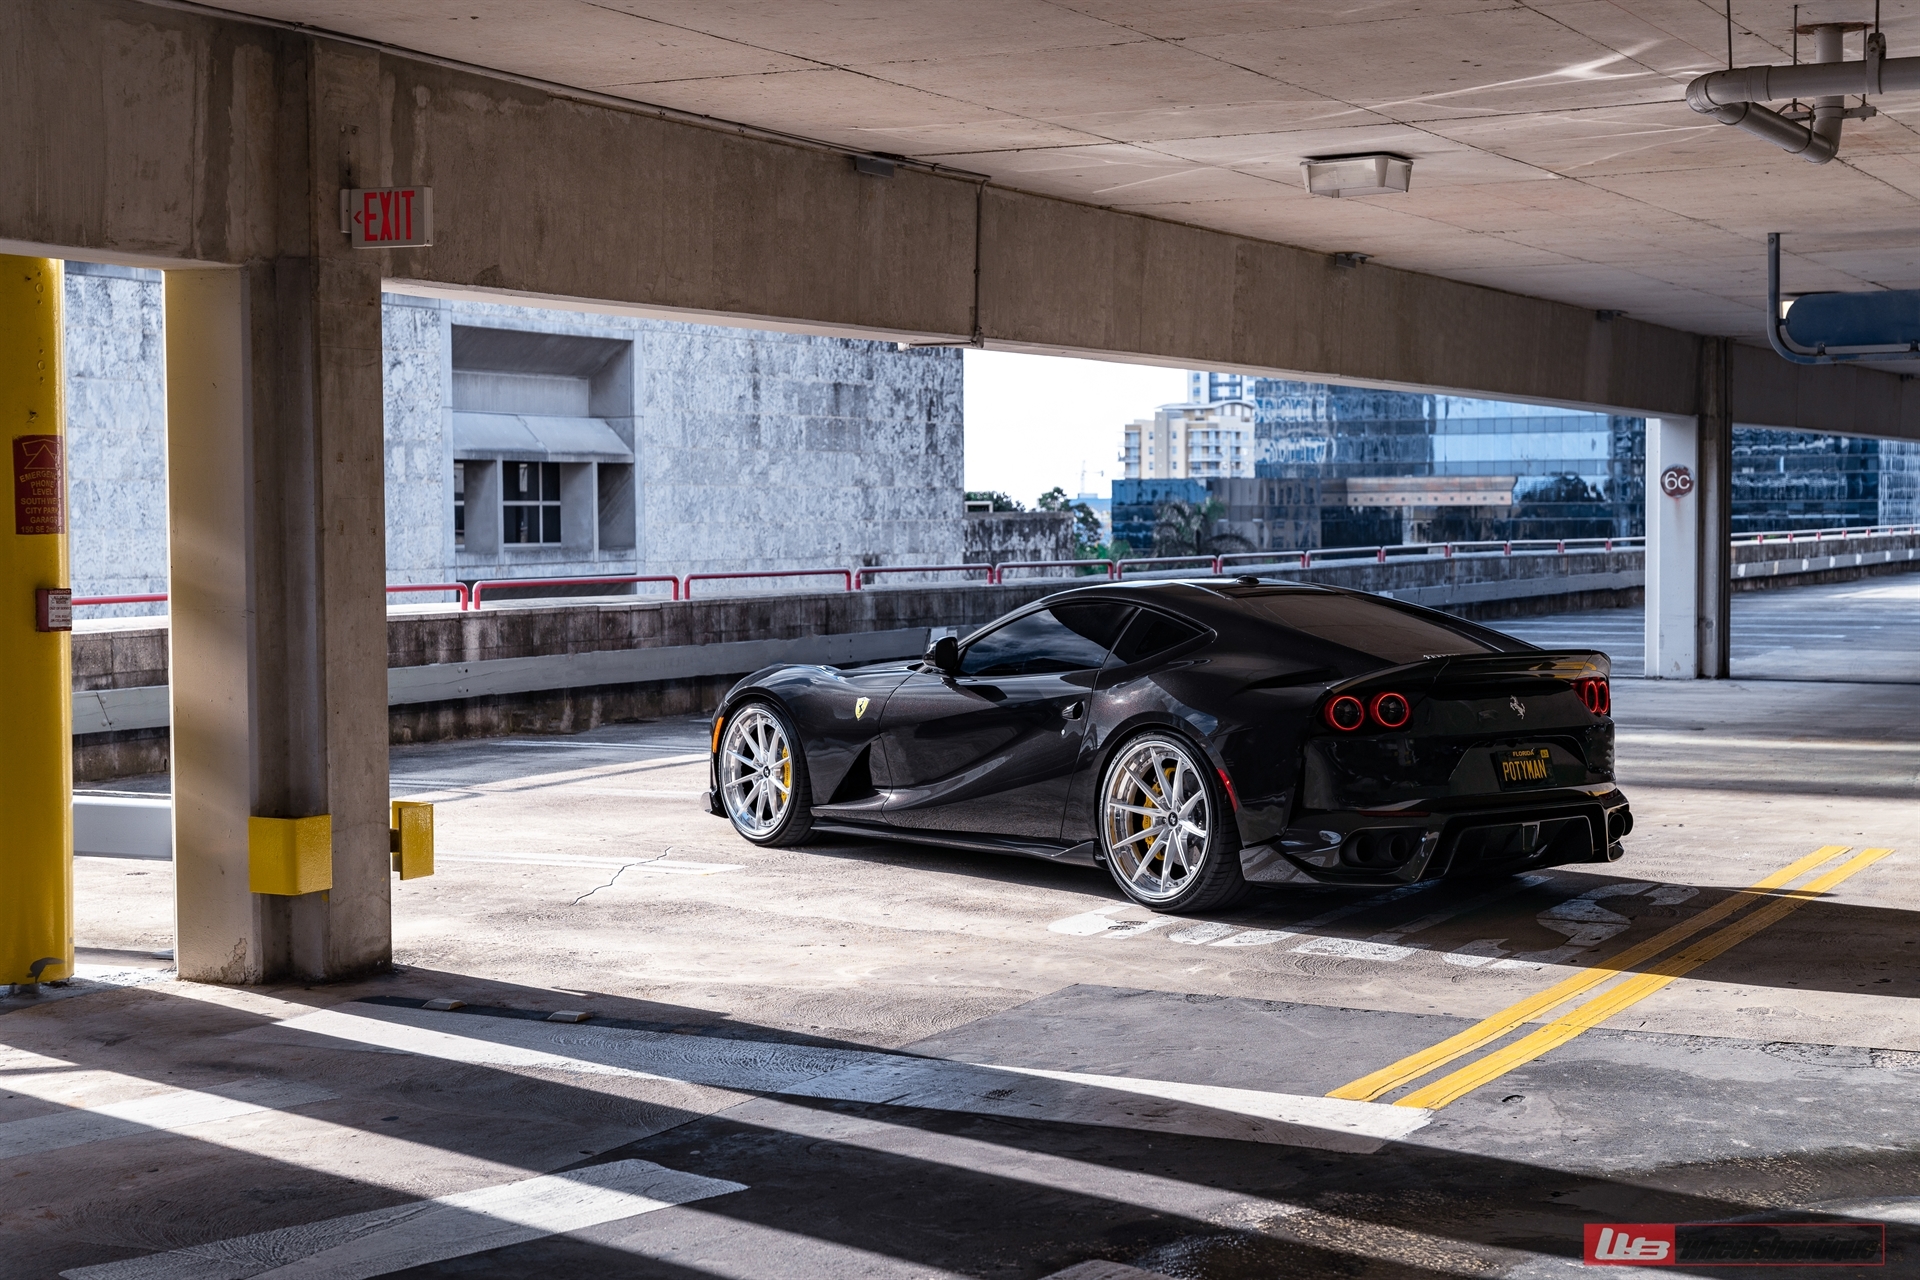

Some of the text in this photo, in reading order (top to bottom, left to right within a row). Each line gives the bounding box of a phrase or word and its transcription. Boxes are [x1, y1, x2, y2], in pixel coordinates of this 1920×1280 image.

[363, 190, 415, 242] EXIT
[30, 479, 54, 489] PHONE
[32, 488, 53, 496] LEVEL
[20, 497, 46, 505] SOUTH
[24, 507, 42, 515] CITY
[20, 525, 34, 533] 150
[35, 525, 45, 533] SE
[1502, 759, 1547, 782] POTYMAN
